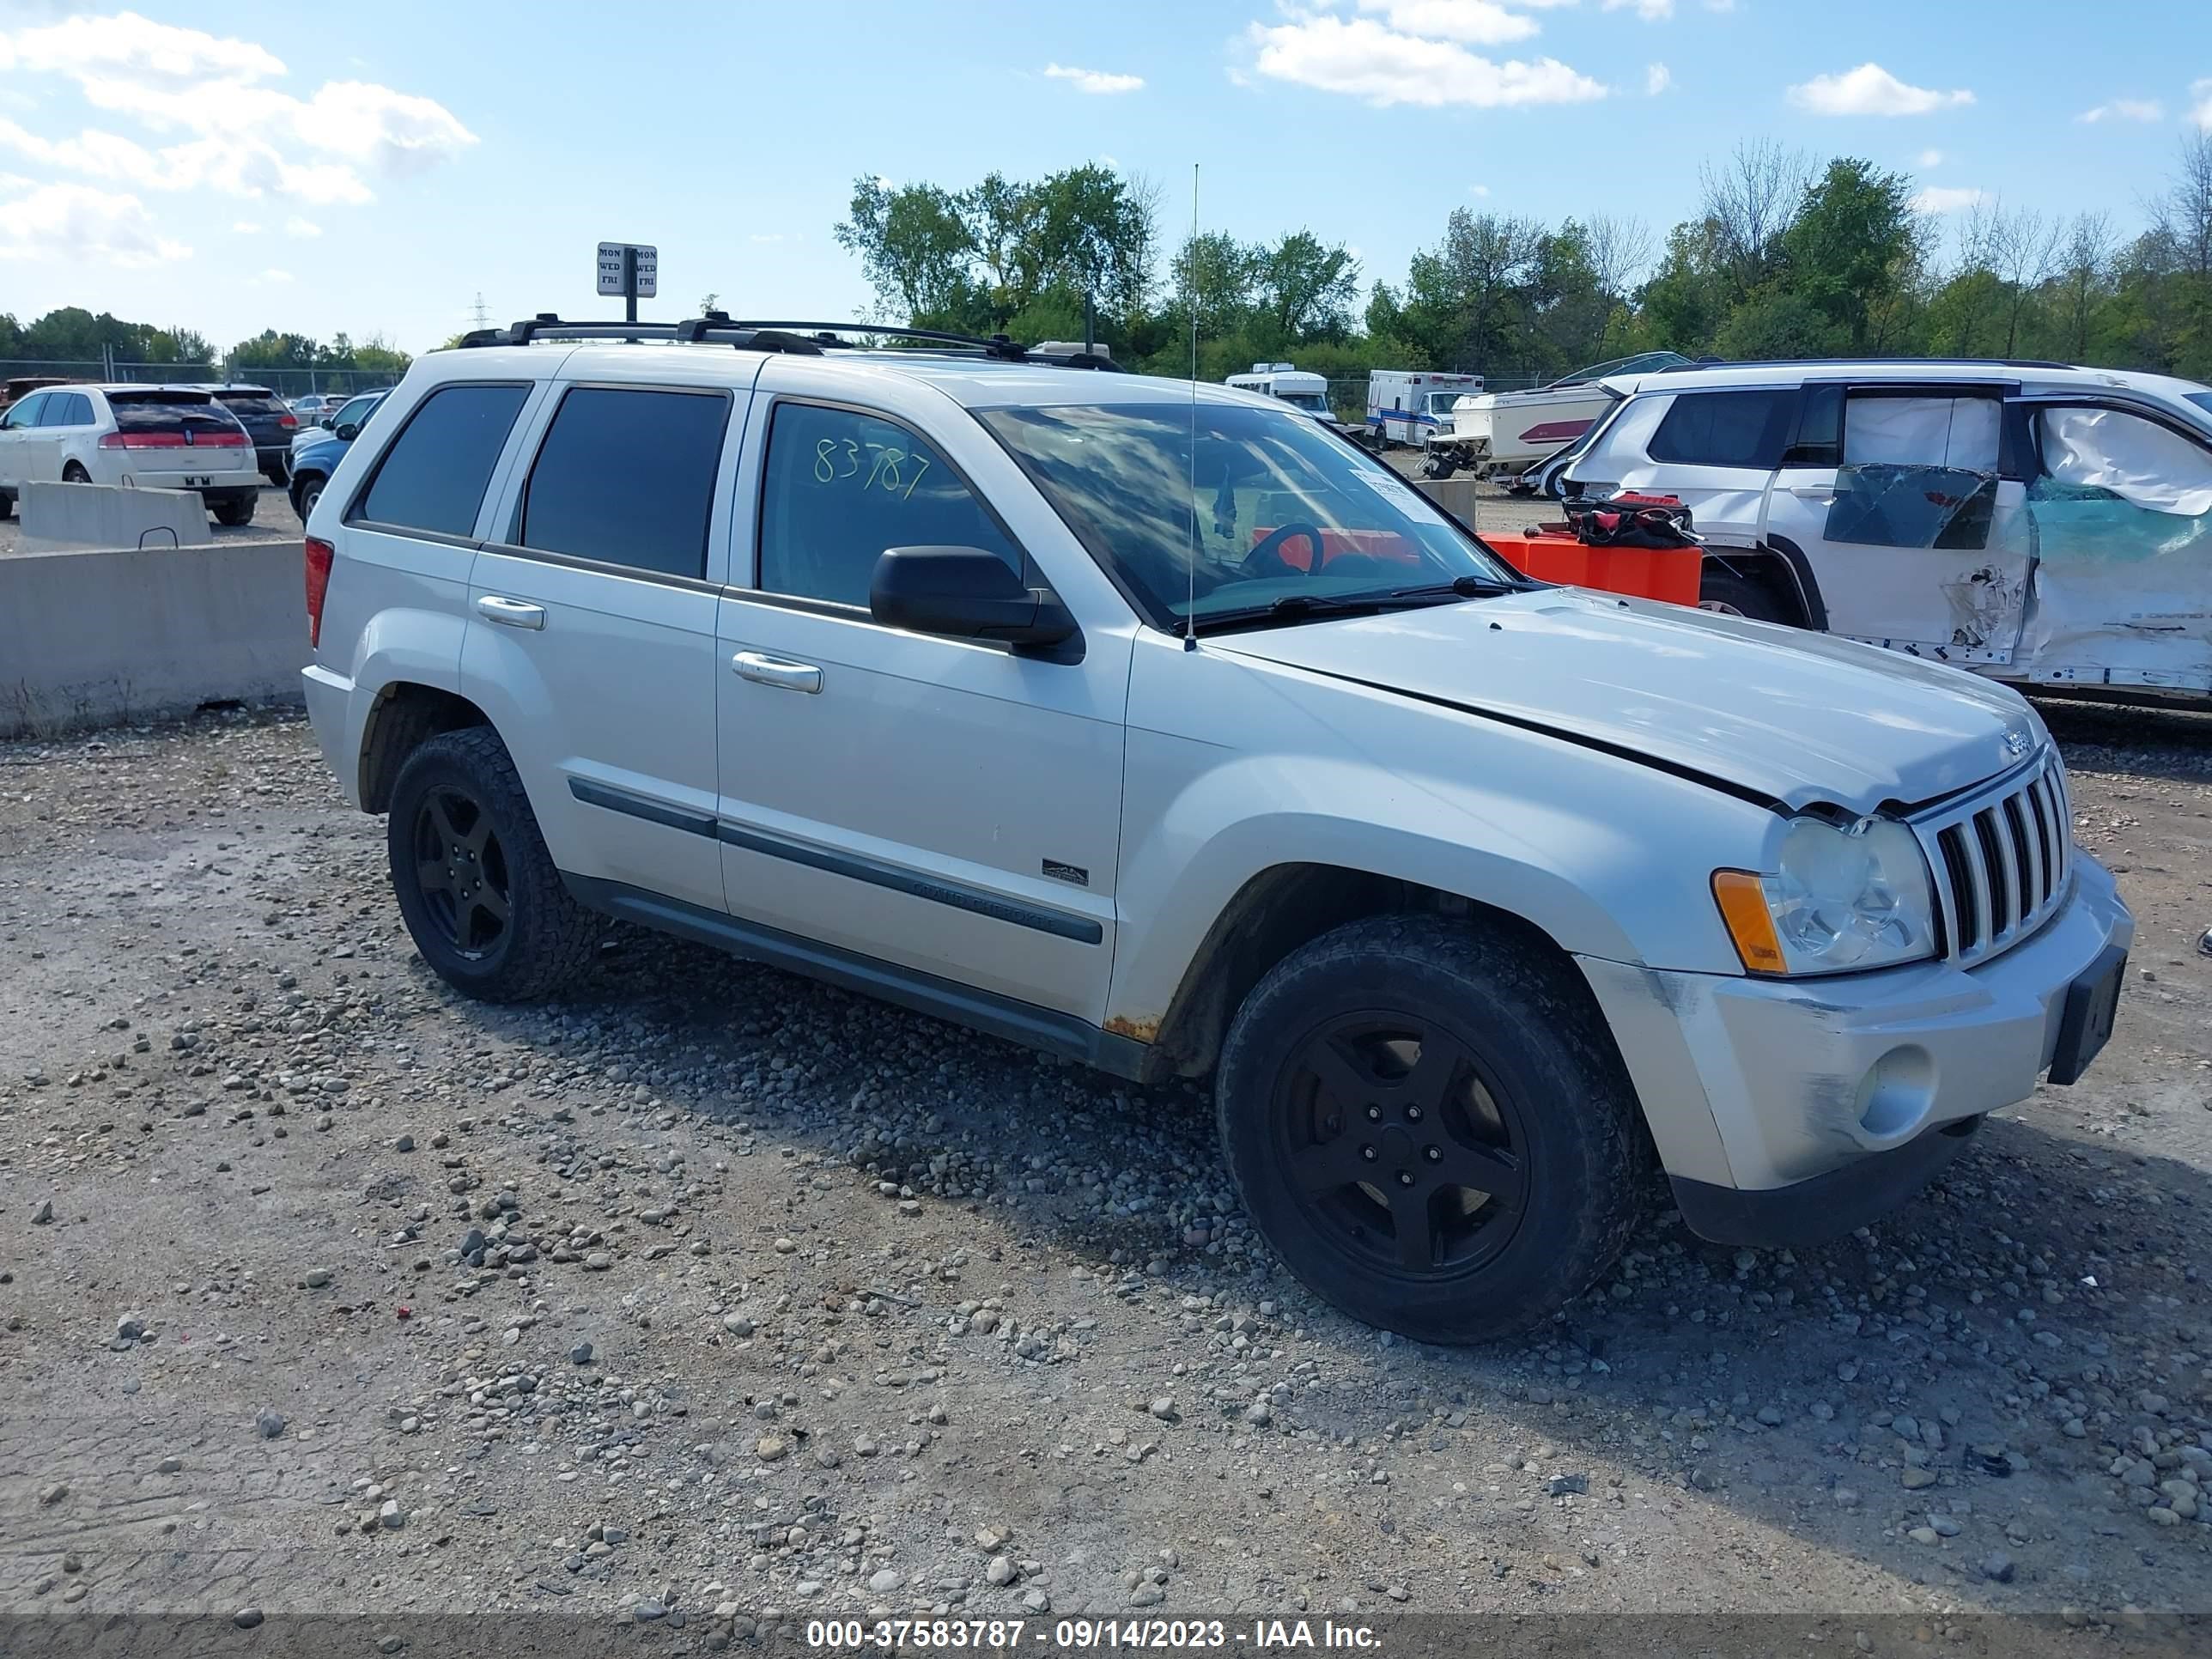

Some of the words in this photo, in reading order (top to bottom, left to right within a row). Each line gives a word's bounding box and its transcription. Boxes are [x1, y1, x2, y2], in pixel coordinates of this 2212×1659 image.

[599, 262, 620, 270] WED
[602, 276, 617, 284] FRI
[814, 438, 931, 501] 83787
